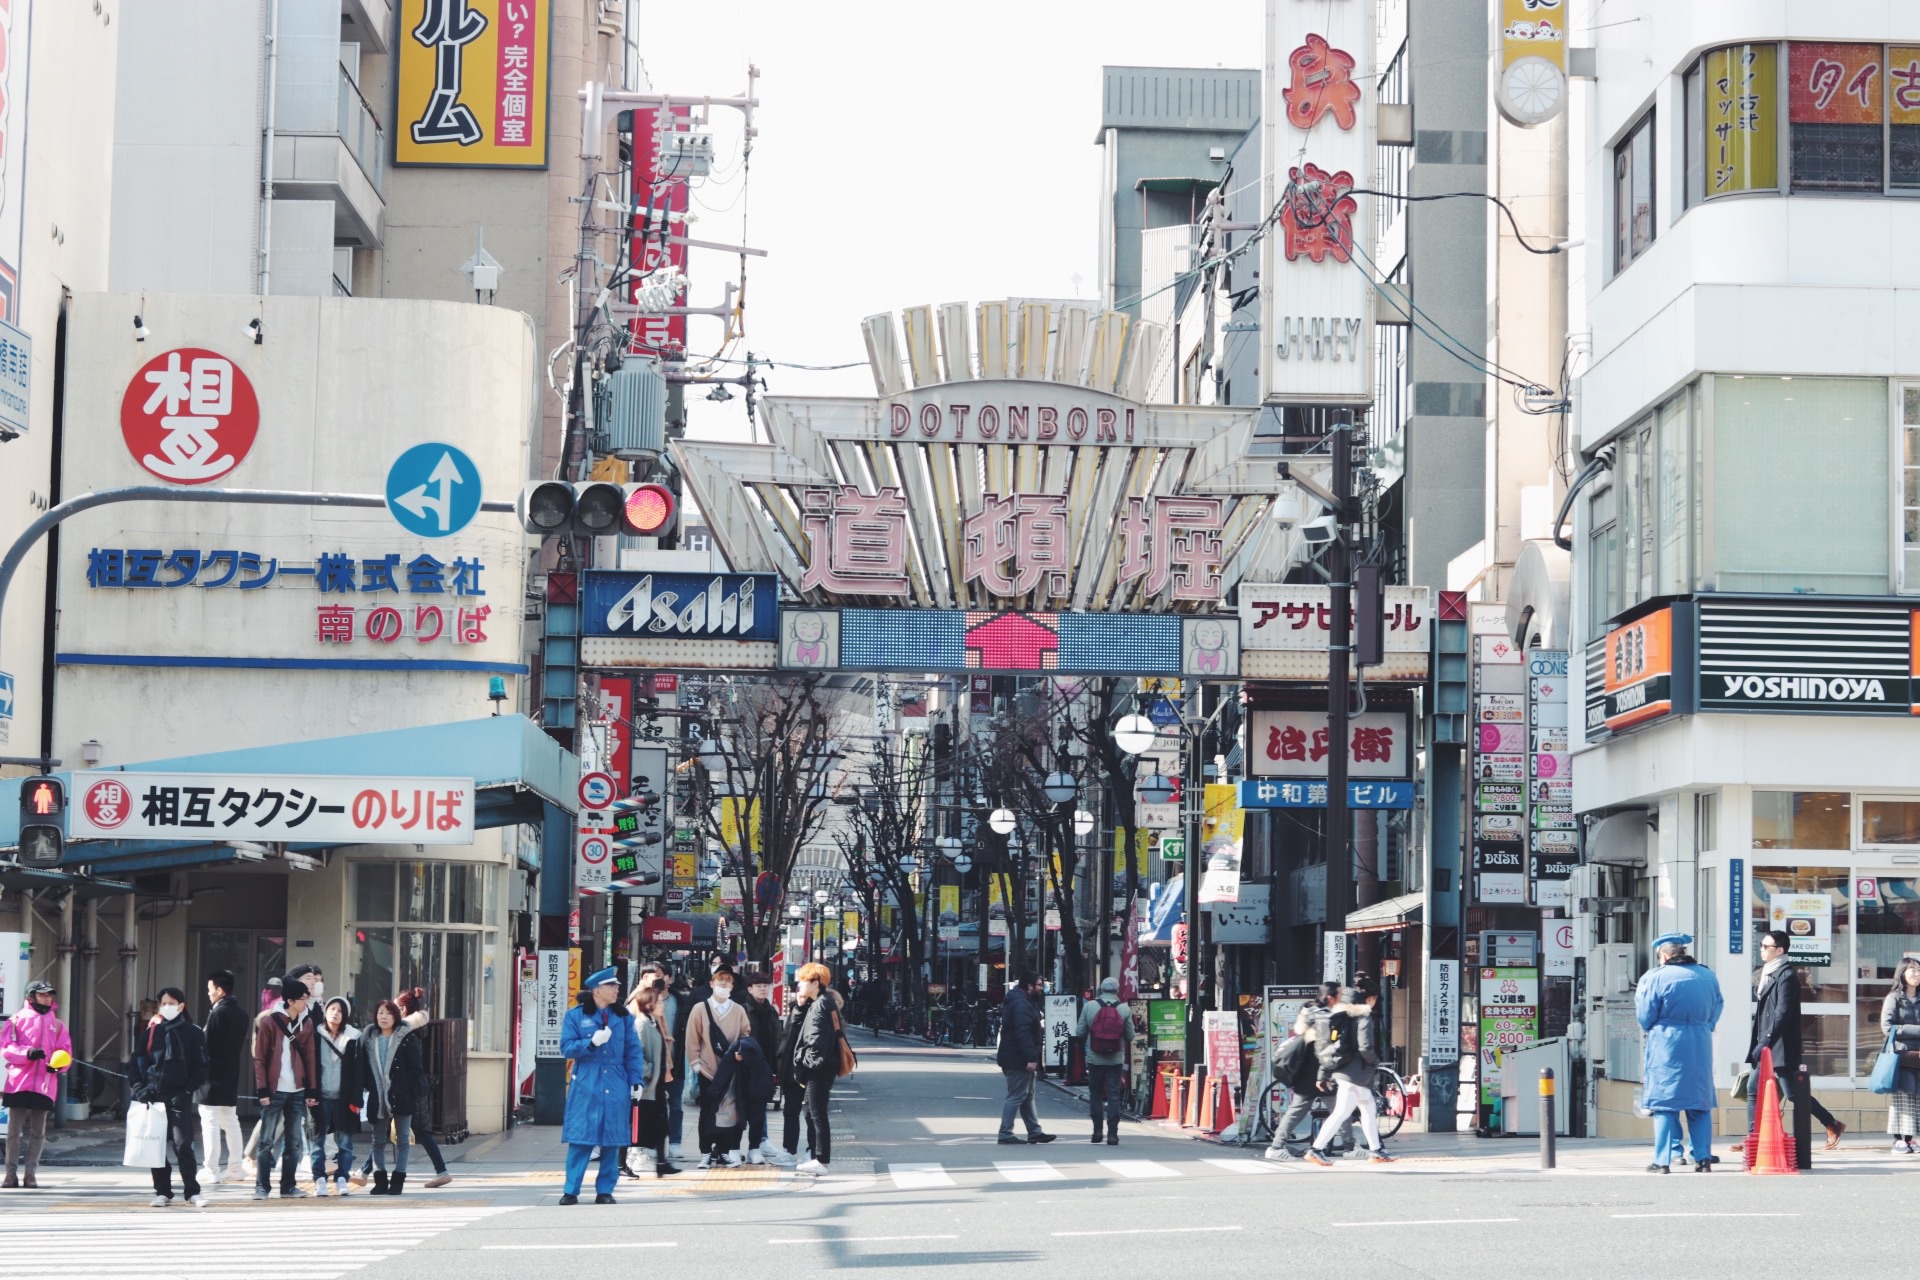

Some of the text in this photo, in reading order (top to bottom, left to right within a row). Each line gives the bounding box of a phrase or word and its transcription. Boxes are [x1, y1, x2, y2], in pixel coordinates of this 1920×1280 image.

[1739, 52, 1759, 131] タイ古式
[1715, 77, 1734, 188] マッサージ
[890, 402, 1136, 441] DOTONBORI
[800, 485, 1225, 599] 道頓堀
[87, 547, 487, 597] 相互タクシー株式会社
[606, 574, 756, 634] Asahi
[1252, 602, 1421, 632] アサヒル
[317, 603, 491, 645] 南のりば
[1536, 652, 1568, 660] RIVERSID
[1616, 690, 1647, 713] YOSHINOYA
[1724, 675, 1886, 701] YOSHINOYA
[1258, 783, 1397, 805] 中和第ビル
[1541, 805, 1572, 813] 全身もみほぐ
[587, 844, 603, 857] 30
[792, 869, 838, 878] OTONBORI
[668, 891, 683, 900] ATM
[547, 954, 559, 1028] 防犯カメラ作動中
[1439, 963, 1450, 1036] 防犯カメラ作動中
[1484, 1006, 1535, 1015] 全身もみほぐし
